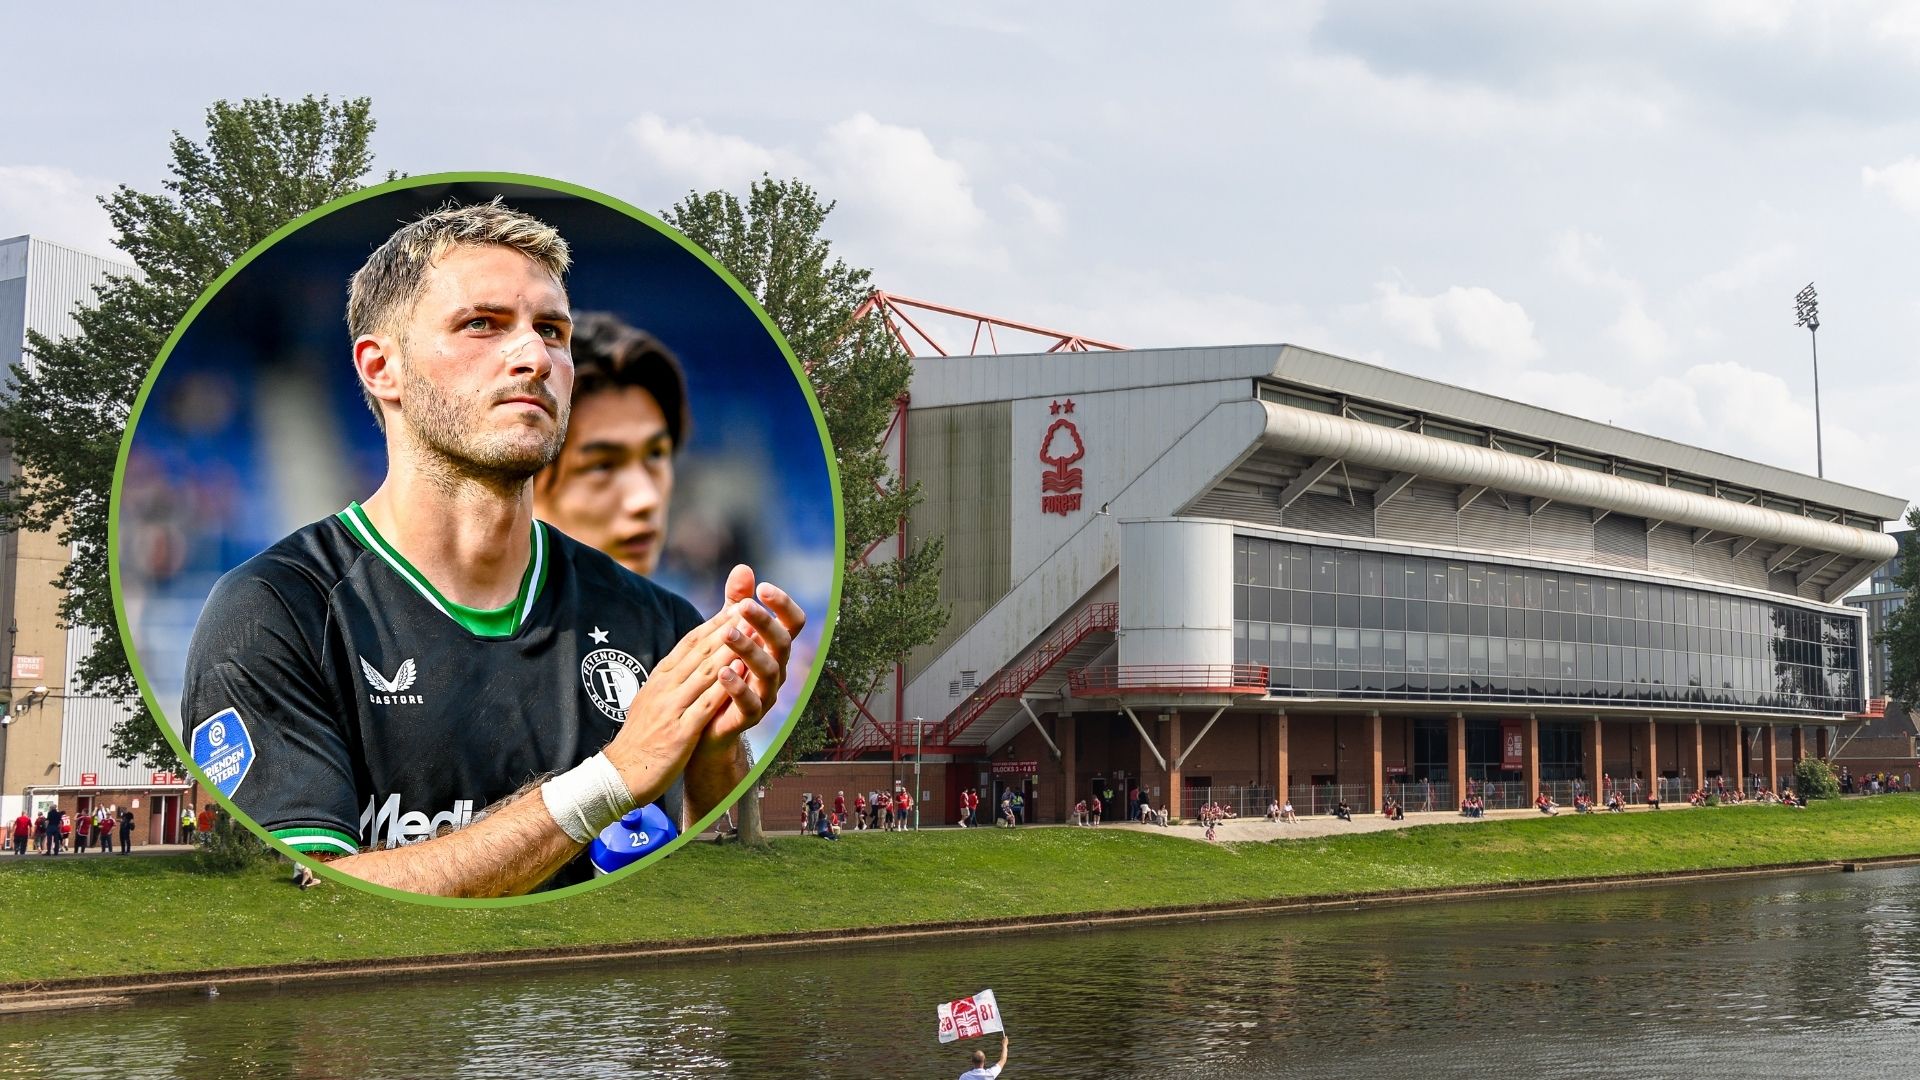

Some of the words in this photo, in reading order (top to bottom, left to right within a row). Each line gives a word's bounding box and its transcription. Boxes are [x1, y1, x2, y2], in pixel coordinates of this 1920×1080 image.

[583, 651, 641, 676] FEYENOORD
[369, 694, 424, 705] CASTORE
[629, 831, 650, 847] 29
